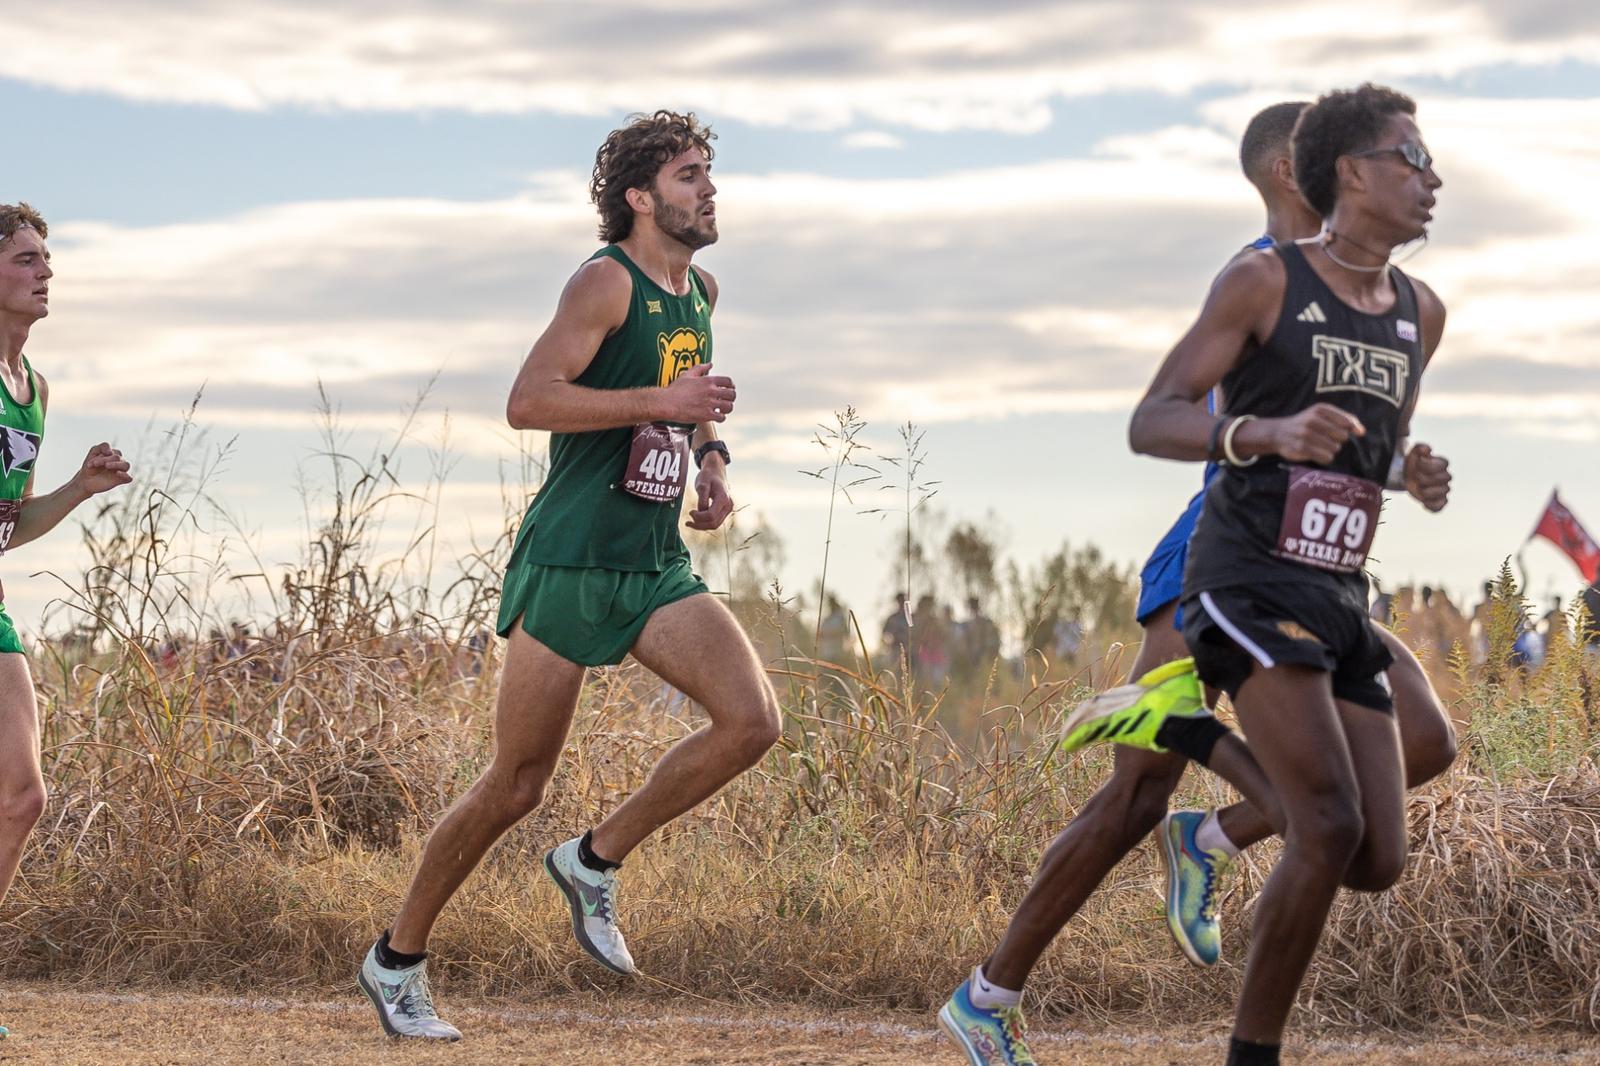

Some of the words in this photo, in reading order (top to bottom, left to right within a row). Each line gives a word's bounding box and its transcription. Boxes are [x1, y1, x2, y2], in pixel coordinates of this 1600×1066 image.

[1313, 335, 1408, 408] TXST
[639, 448, 681, 483] 404
[635, 480, 666, 496] TEXAS
[1301, 498, 1368, 549] 679
[1298, 539, 1342, 563] TEXAS
